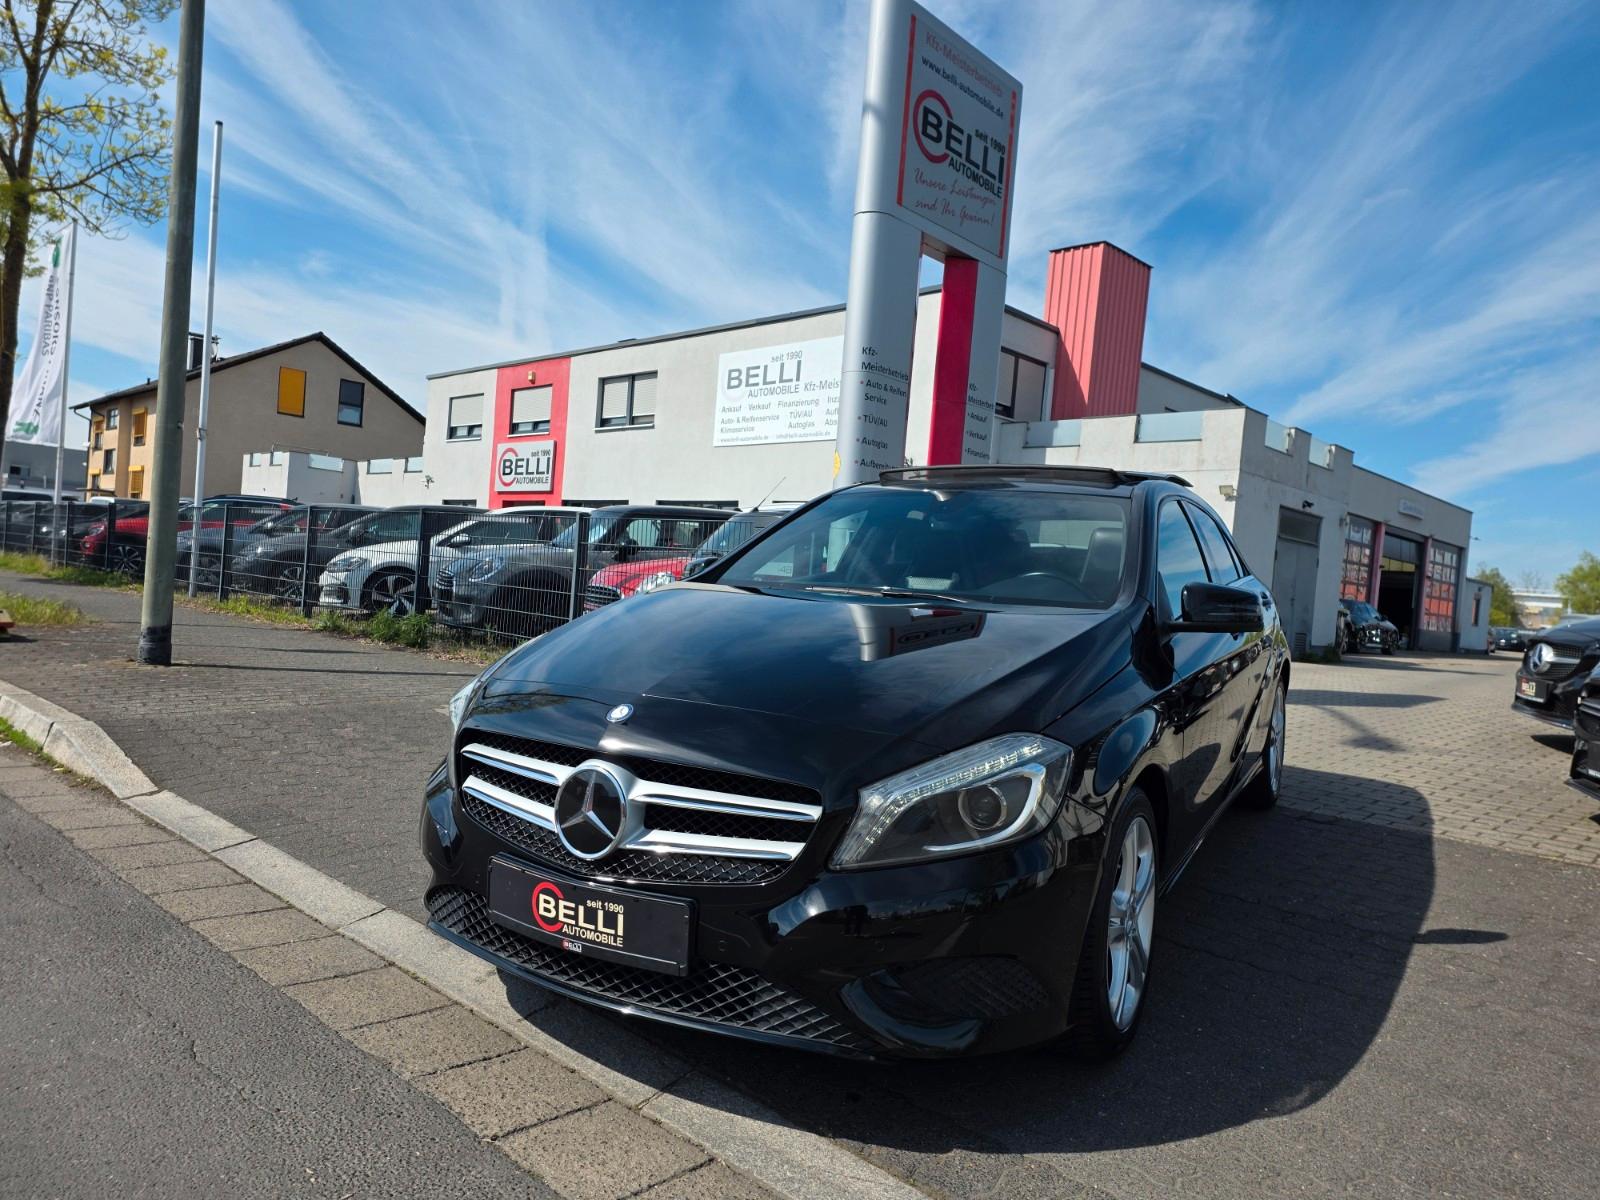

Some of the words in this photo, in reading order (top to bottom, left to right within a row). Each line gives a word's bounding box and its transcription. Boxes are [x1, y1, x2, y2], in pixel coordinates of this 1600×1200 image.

[921, 56, 1004, 119] www.belli-automobile.de
[921, 105, 1006, 185] BELLI
[990, 137, 1006, 156] 1990
[948, 157, 1003, 200] AUTOMOBILE
[41, 302, 53, 357] PARIBAS
[786, 350, 803, 361] 1990
[862, 346, 878, 357] Kfz-
[727, 359, 802, 390] BELLI
[861, 361, 909, 381] Meisterbetrieb
[748, 384, 800, 399] AUTOMOBILE
[866, 379, 883, 390] Auto
[863, 414, 888, 427] TÜV/AU
[502, 457, 551, 476] BELLI
[515, 476, 550, 485] AUTOMOBILE
[538, 893, 624, 937] BELLI
[586, 899, 602, 910] seit
[603, 902, 624, 914] 1990
[562, 923, 624, 948] AUTOMOBILE
